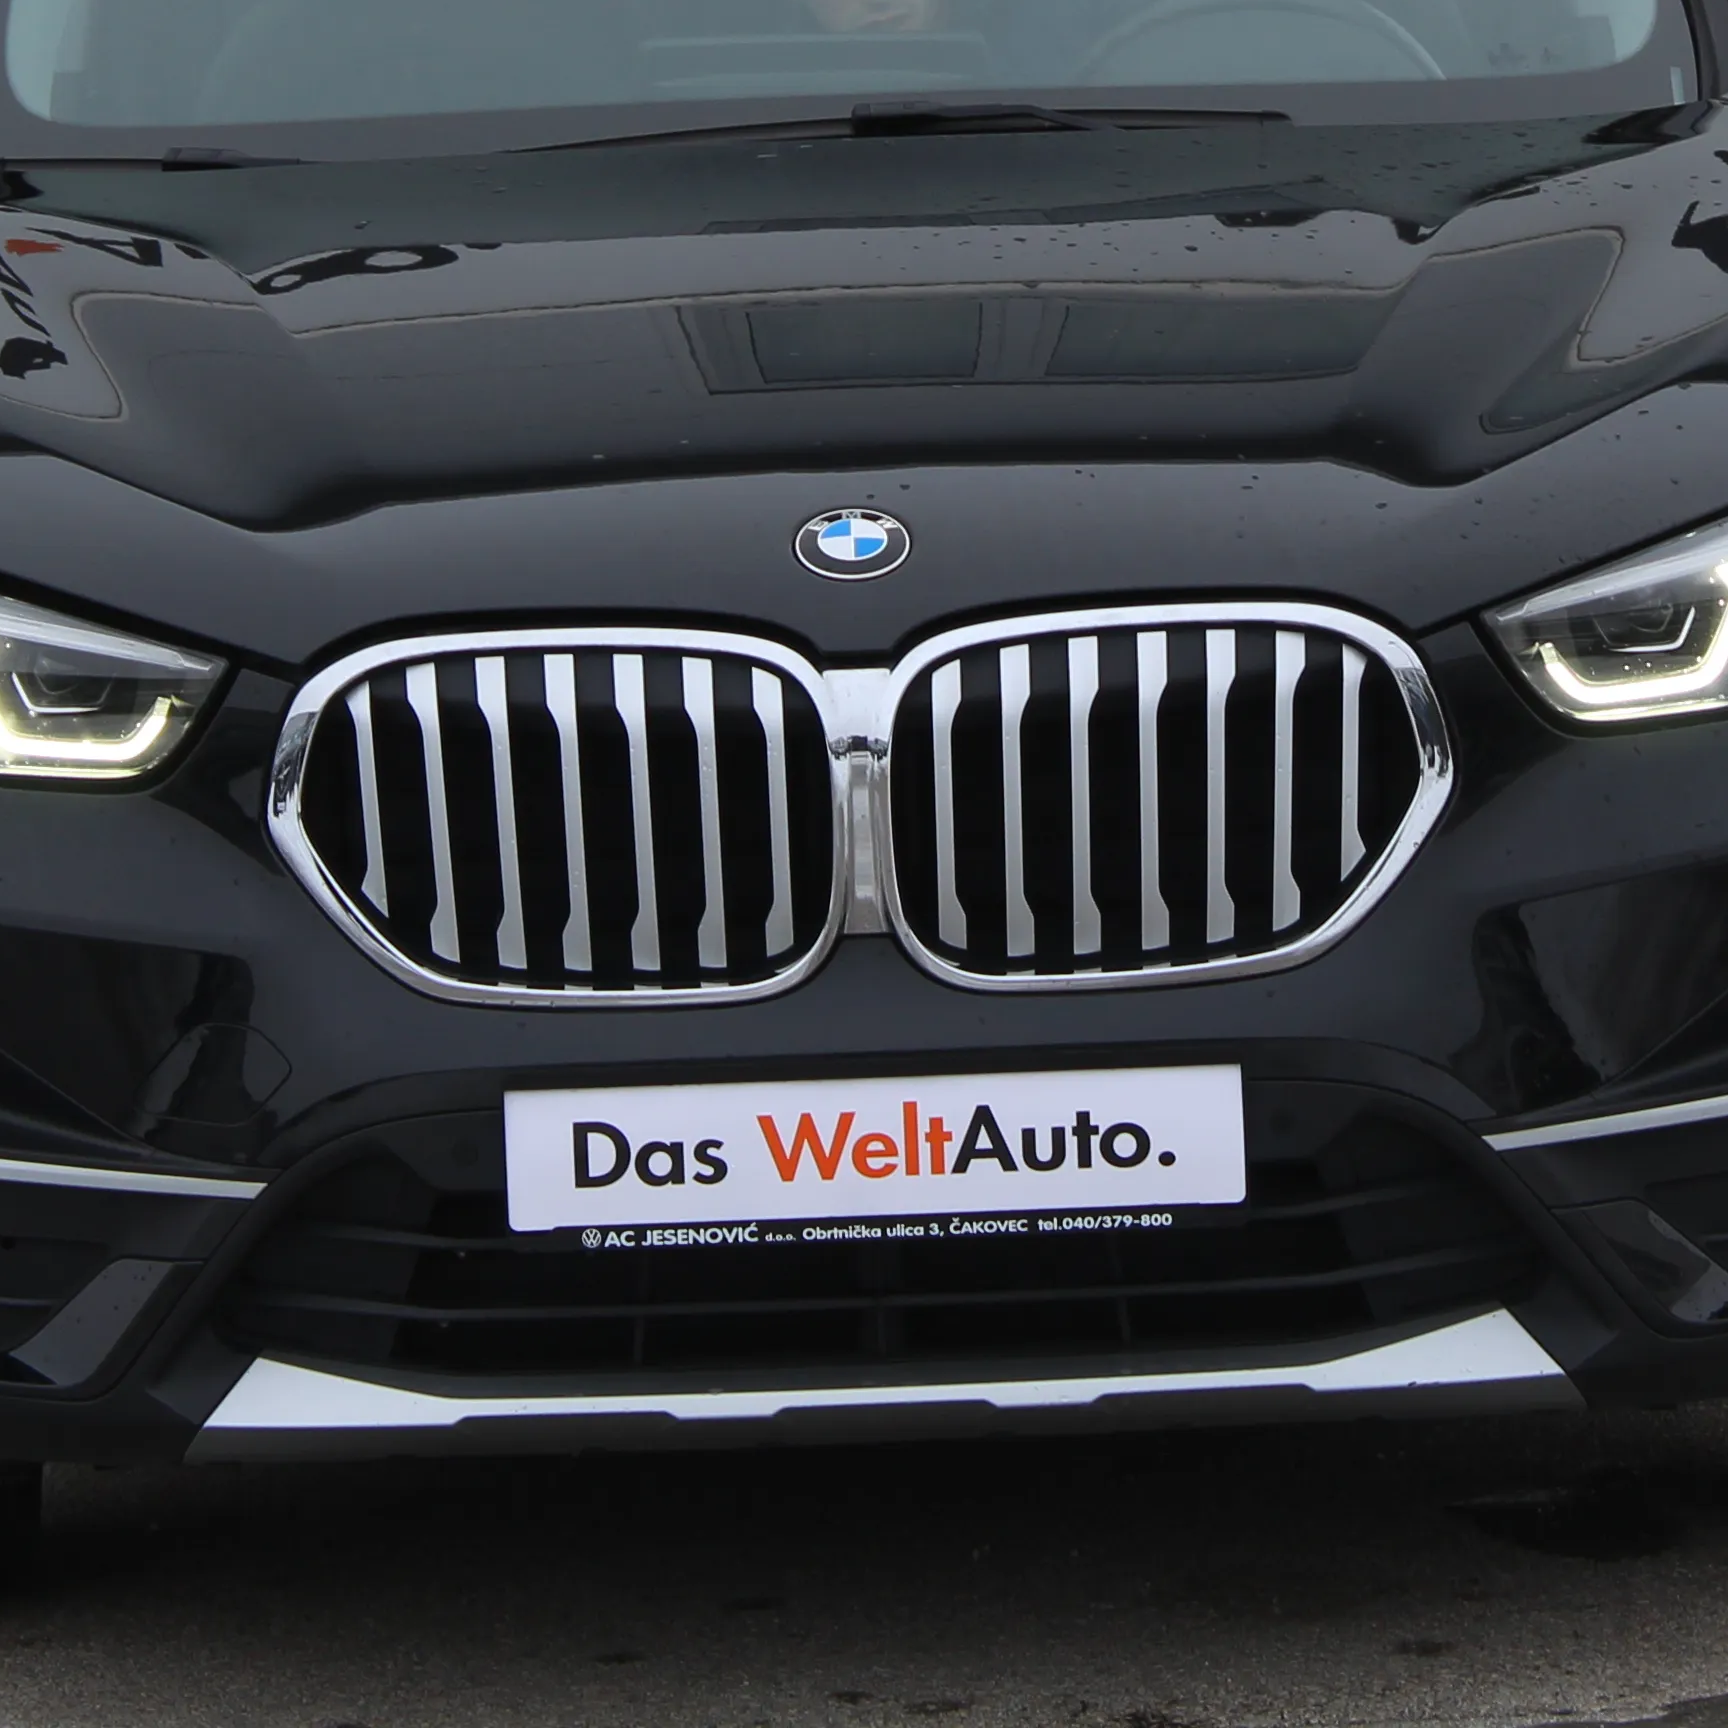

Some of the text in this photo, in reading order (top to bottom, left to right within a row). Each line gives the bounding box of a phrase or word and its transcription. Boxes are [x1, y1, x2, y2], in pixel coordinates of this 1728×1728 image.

[807, 509, 898, 532] BMW
[572, 1100, 1177, 1188] Das WeltAuto.
[604, 1230, 635, 1248] AC
[641, 1222, 759, 1247] JESENOVIĆ
[765, 1232, 797, 1243] d.o.o.
[802, 1224, 881, 1241] Obrtnička
[886, 1223, 924, 1238] ulica
[929, 1223, 945, 1237] 3,
[949, 1217, 1029, 1235] ČAKOVEC
[1037, 1213, 1173, 1232] tel.040/379-800
